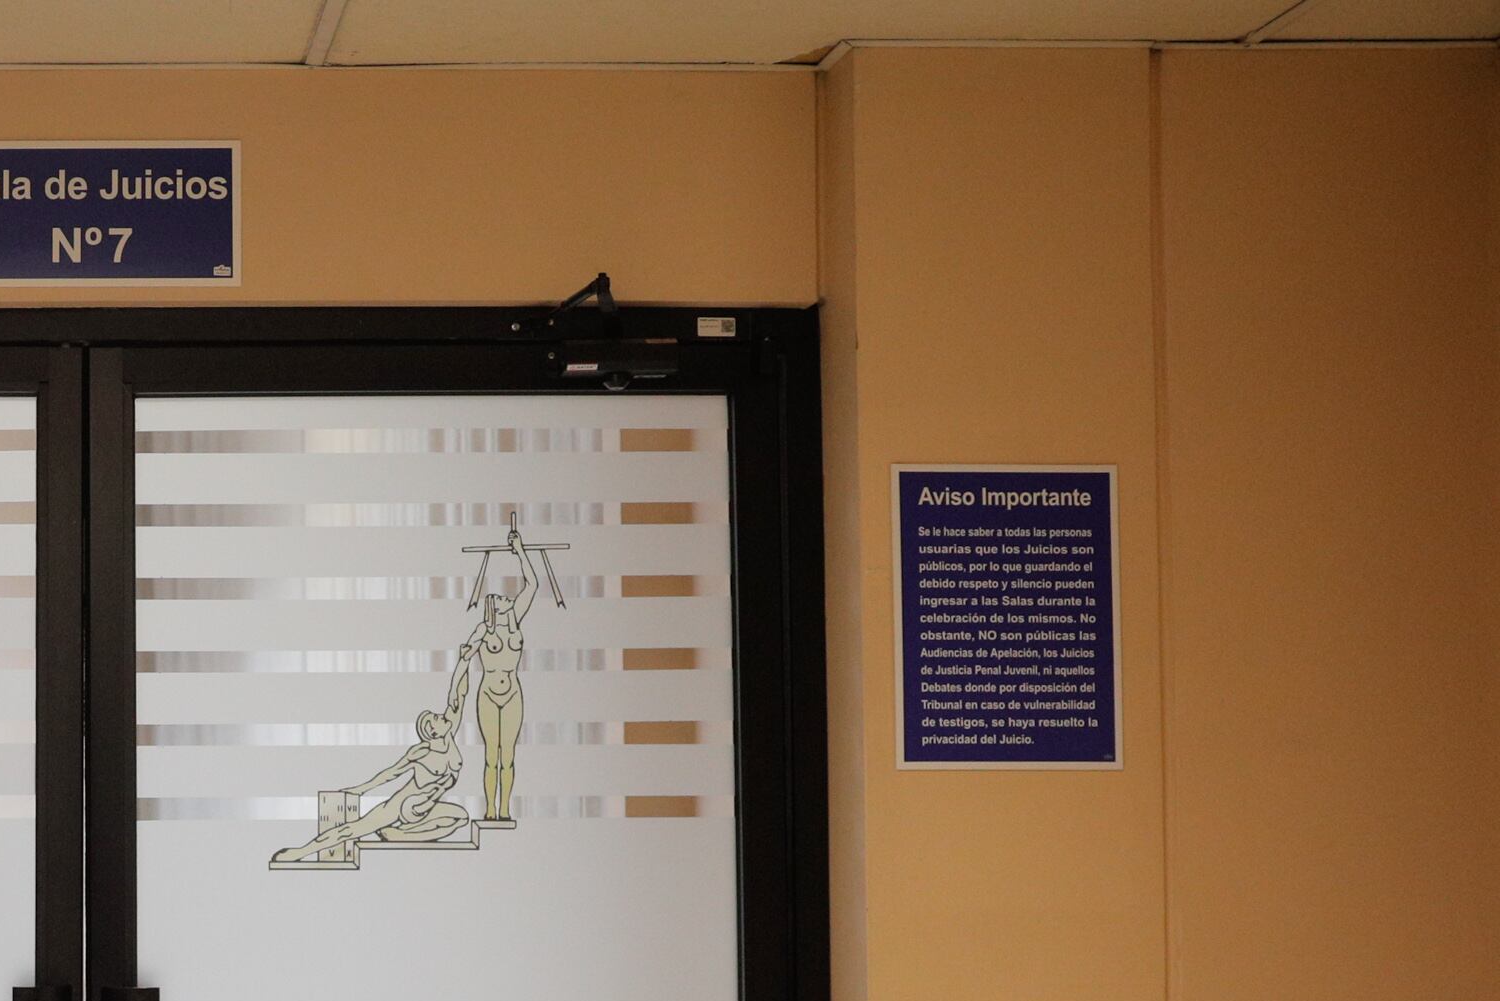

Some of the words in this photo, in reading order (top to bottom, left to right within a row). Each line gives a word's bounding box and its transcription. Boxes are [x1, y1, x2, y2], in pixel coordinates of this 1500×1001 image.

[44, 169, 88, 200] de
[99, 168, 228, 201] Juicios
[918, 487, 974, 505] Aviso
[982, 488, 1091, 510] Importante
[918, 526, 930, 536] Se
[933, 527, 941, 536] le
[944, 526, 966, 536] hace
[968, 527, 994, 536] saber
[1005, 528, 1030, 536] todas
[1034, 528, 1046, 537] las
[1050, 530, 1092, 538] personas
[919, 544, 971, 554] usuarias
[975, 546, 998, 556] que
[1002, 544, 1020, 554] los
[1024, 544, 1068, 554] Juicios
[919, 561, 966, 573] públicos,
[969, 564, 987, 573] por
[990, 562, 1000, 571] lo
[1002, 564, 1022, 573] que
[1025, 562, 1080, 574] guardando
[1084, 562, 1092, 571] el
[919, 578, 956, 588] debido
[959, 580, 998, 590] respeto
[1011, 579, 1052, 588] silencio
[1055, 579, 1094, 590] pueden
[920, 596, 968, 608] ingresar
[982, 596, 998, 606] las
[1002, 596, 1034, 606] Salas
[1037, 596, 1082, 606] durante
[1086, 596, 1095, 606] la
[920, 613, 986, 623] celebración
[990, 613, 1004, 623] de
[1008, 613, 1024, 623] los
[1028, 614, 1076, 623] mismos.
[1080, 614, 1096, 623] No
[920, 630, 974, 641] obstante,
[979, 630, 997, 640] NO
[1026, 630, 1075, 642] públicas
[1080, 631, 1096, 640] las
[920, 648, 973, 658] Audiencias
[976, 648, 988, 657] de
[990, 648, 1040, 660] Apelación,
[1044, 648, 1058, 658] los
[1060, 648, 1094, 658] Juicios
[921, 665, 932, 675] de
[935, 665, 972, 675] Justicia
[975, 665, 1001, 675] Penal
[1004, 665, 1040, 676] Juvenil,
[1043, 666, 1052, 674] ni
[1055, 666, 1094, 677] aquellos
[921, 682, 962, 692] Debates
[965, 682, 996, 692] donde
[1000, 685, 1016, 694] por
[1019, 682, 1077, 694] disposición
[1080, 683, 1095, 692] del
[921, 700, 962, 710] Tribunal
[965, 702, 978, 710] en
[981, 702, 1005, 710] caso
[1008, 700, 1021, 710] de
[1024, 700, 1095, 710] vulnerabilidad
[922, 717, 936, 727] de
[939, 717, 988, 729] testigos,
[992, 719, 1005, 727] se
[1008, 718, 1035, 729] haya
[1039, 717, 1084, 727] resuelto
[1088, 717, 1098, 727] la
[922, 734, 977, 746] privacidad
[980, 734, 996, 744] del
[1000, 734, 1034, 744] Juicio.
